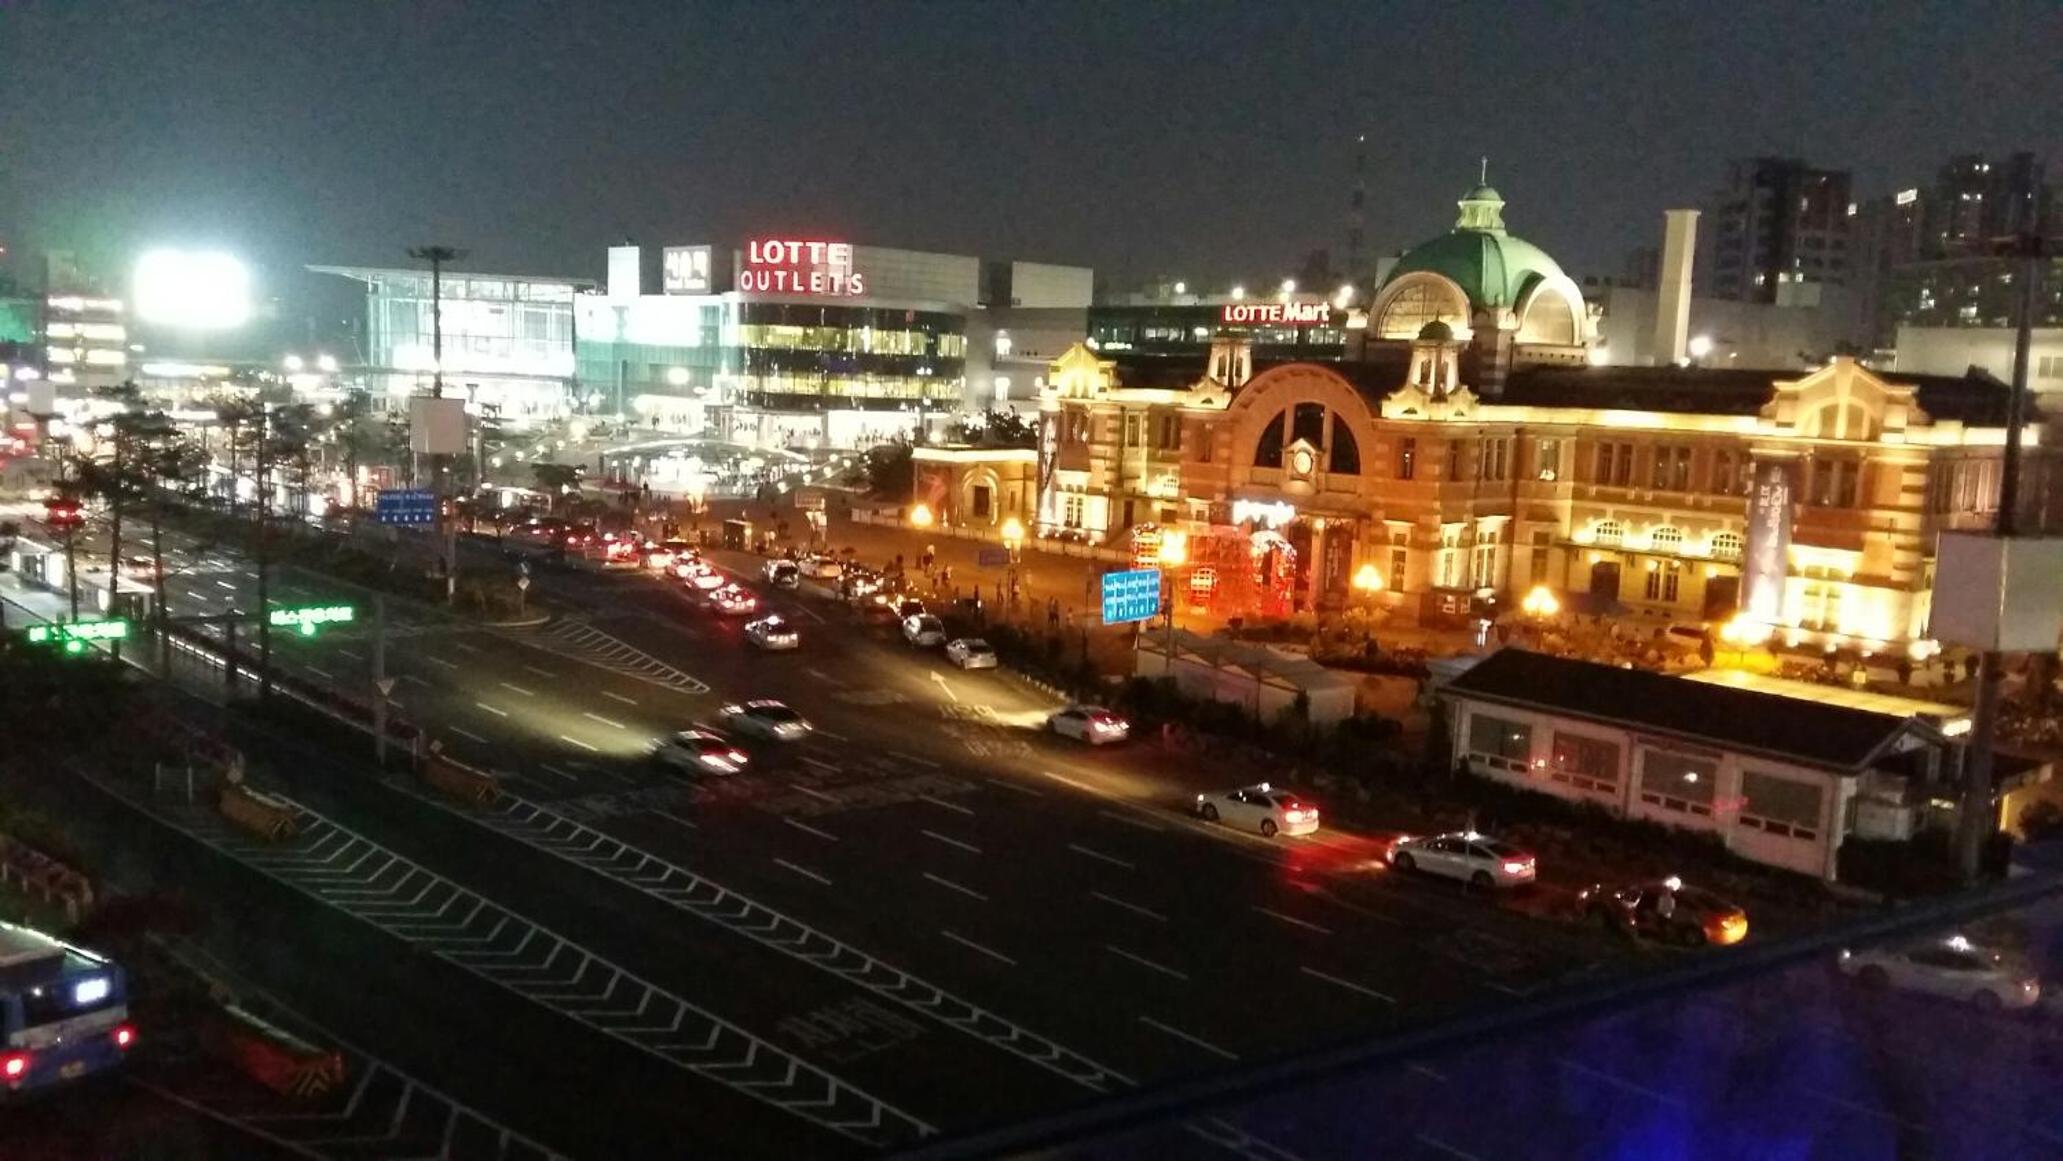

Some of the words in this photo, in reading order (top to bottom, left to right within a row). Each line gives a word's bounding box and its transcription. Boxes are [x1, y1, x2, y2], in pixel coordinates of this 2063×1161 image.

[750, 240, 848, 265] LOTTE
[741, 270, 863, 294] OUTLETS
[1224, 305, 1281, 321] LOTTE
[1283, 301, 1330, 321] Mart
